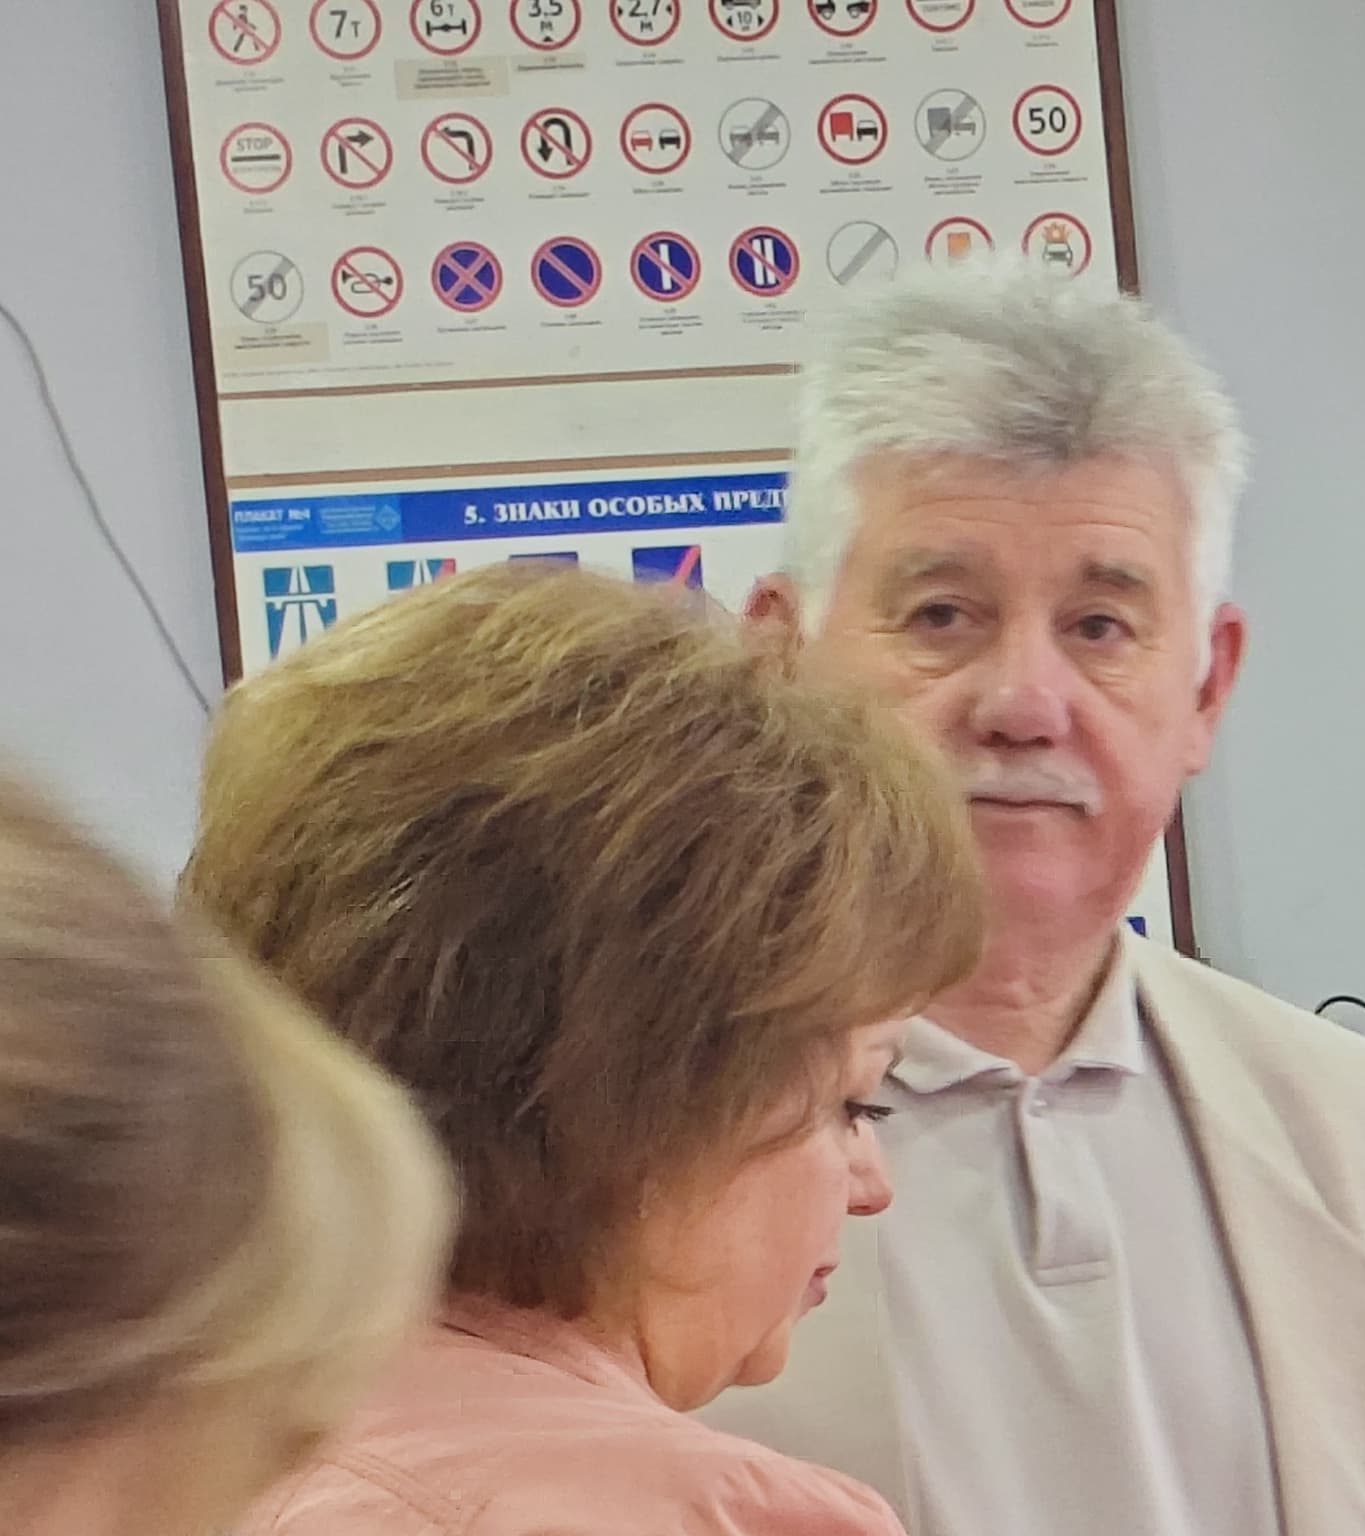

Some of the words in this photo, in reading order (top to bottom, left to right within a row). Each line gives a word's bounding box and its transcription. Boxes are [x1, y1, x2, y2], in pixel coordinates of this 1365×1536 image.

[1028, 106, 1067, 135] 50
[236, 137, 273, 151] STOP
[247, 273, 287, 301] 50
[464, 505, 486, 525] 5.
[494, 499, 580, 523] ЗНАКИ
[588, 492, 705, 517] ОСОБЫХ
[714, 488, 788, 512] ПРЕД
